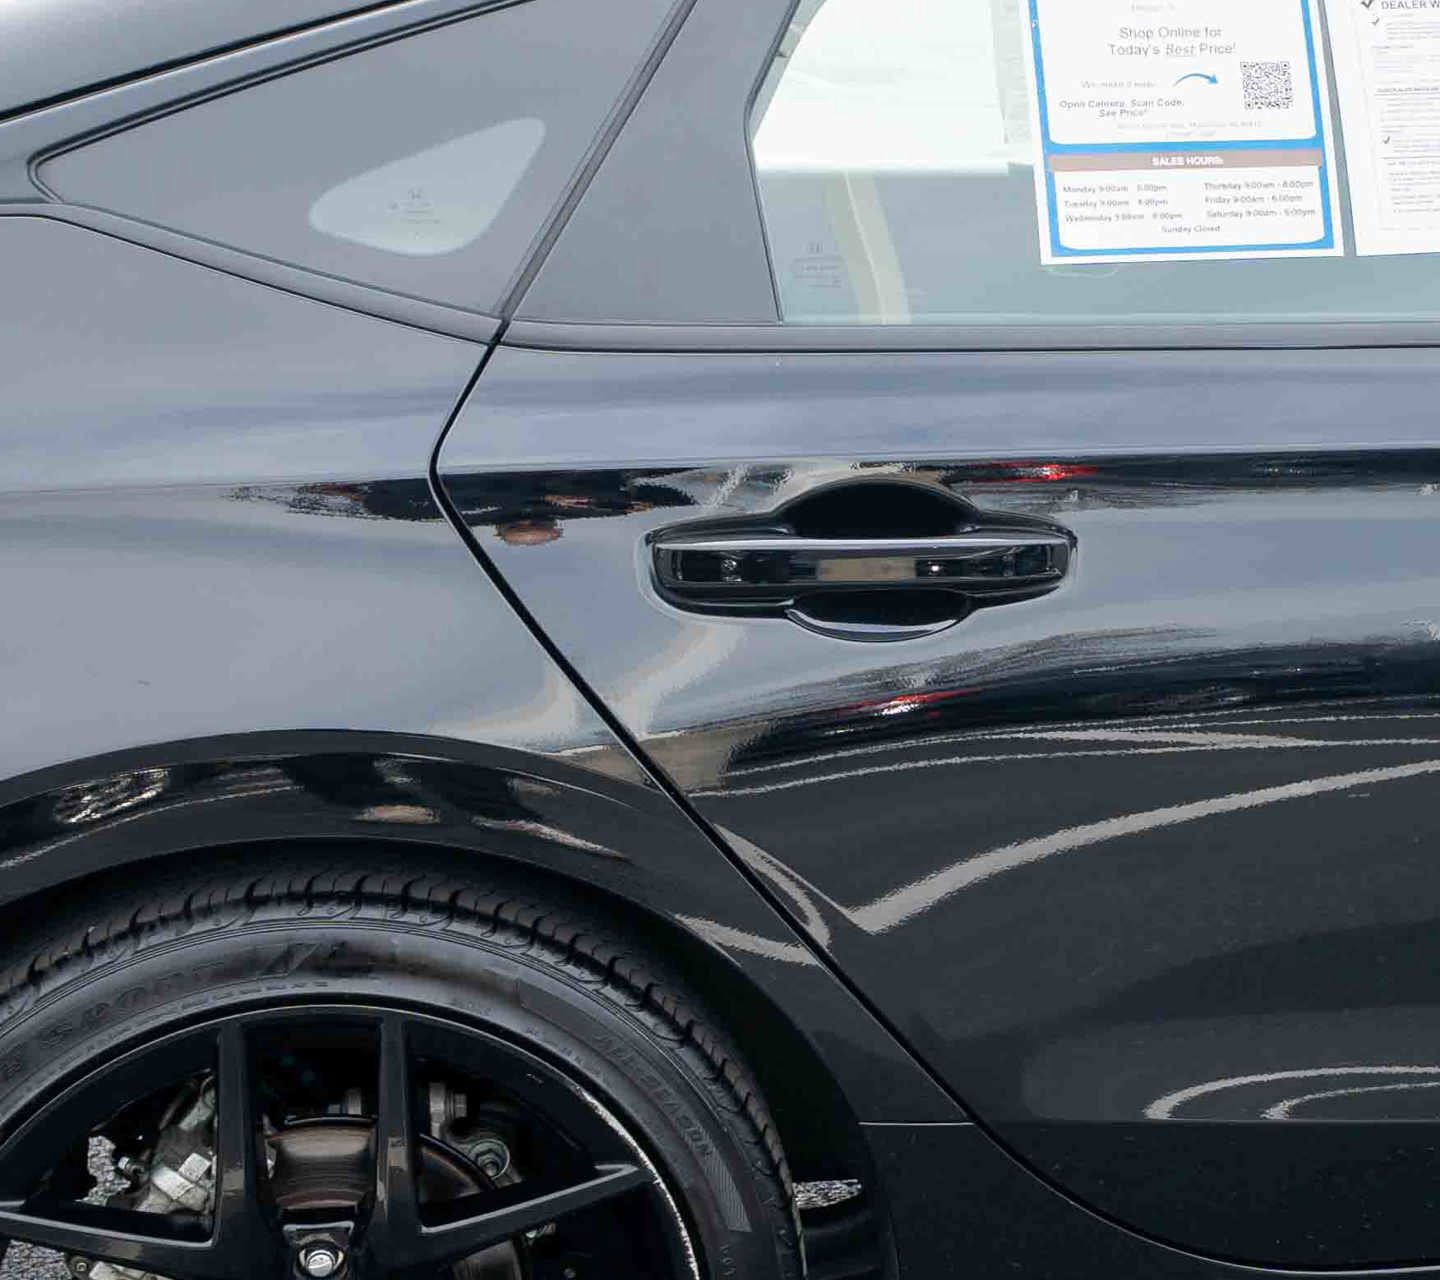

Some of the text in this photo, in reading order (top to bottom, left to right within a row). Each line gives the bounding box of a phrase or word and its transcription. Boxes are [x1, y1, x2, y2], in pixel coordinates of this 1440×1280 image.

[1381, 0, 1427, 10] DEALER
[1119, 26, 1222, 40] Shop Online for
[1109, 43, 1160, 57] Today's
[1199, 42, 1236, 55] Price!
[1060, 100, 1086, 110] Open
[1152, 156, 1185, 166] SALES
[1204, 196, 1231, 205] Friday
[1161, 225, 1192, 234] Sunday
